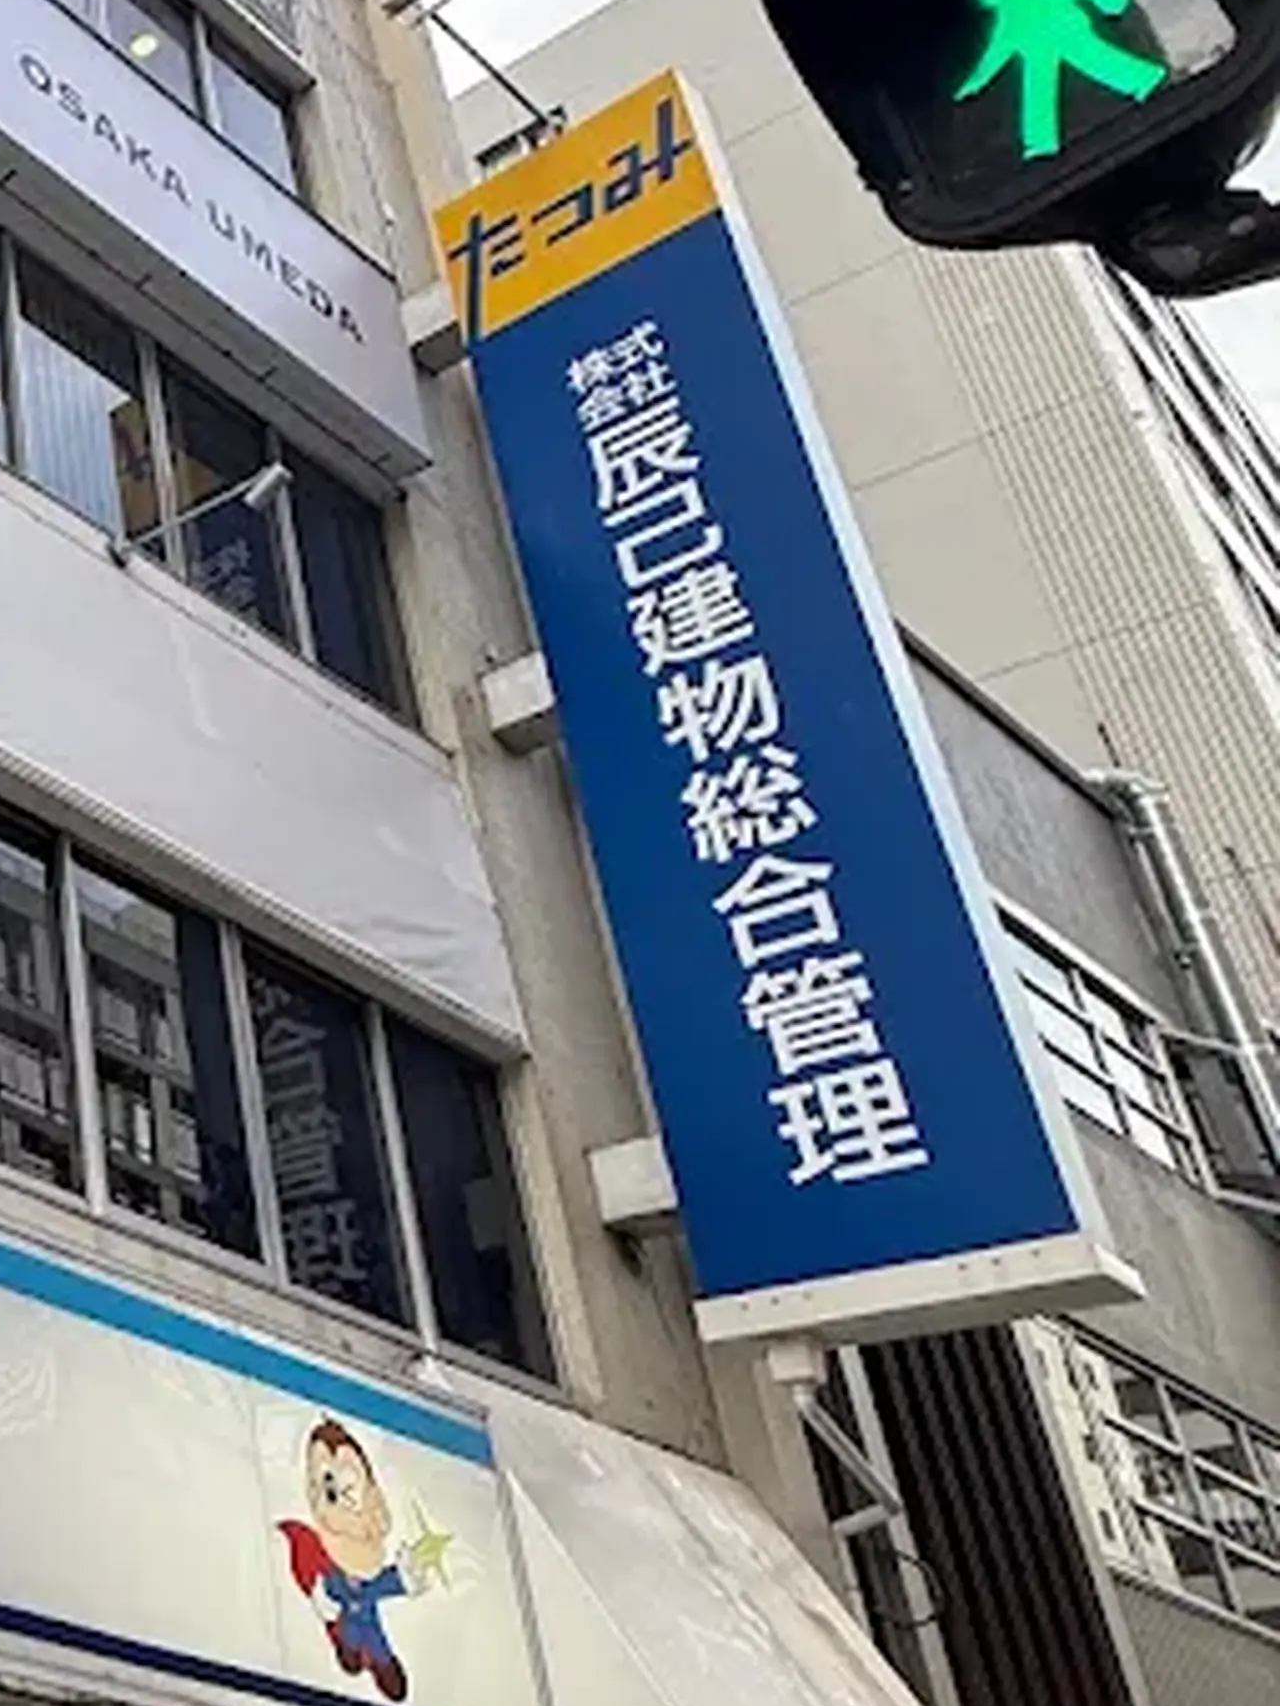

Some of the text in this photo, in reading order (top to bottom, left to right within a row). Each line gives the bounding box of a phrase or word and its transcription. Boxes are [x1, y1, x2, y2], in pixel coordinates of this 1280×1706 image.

[17, 51, 368, 347] OSAKA UMEDA
[447, 98, 696, 345] たつみ
